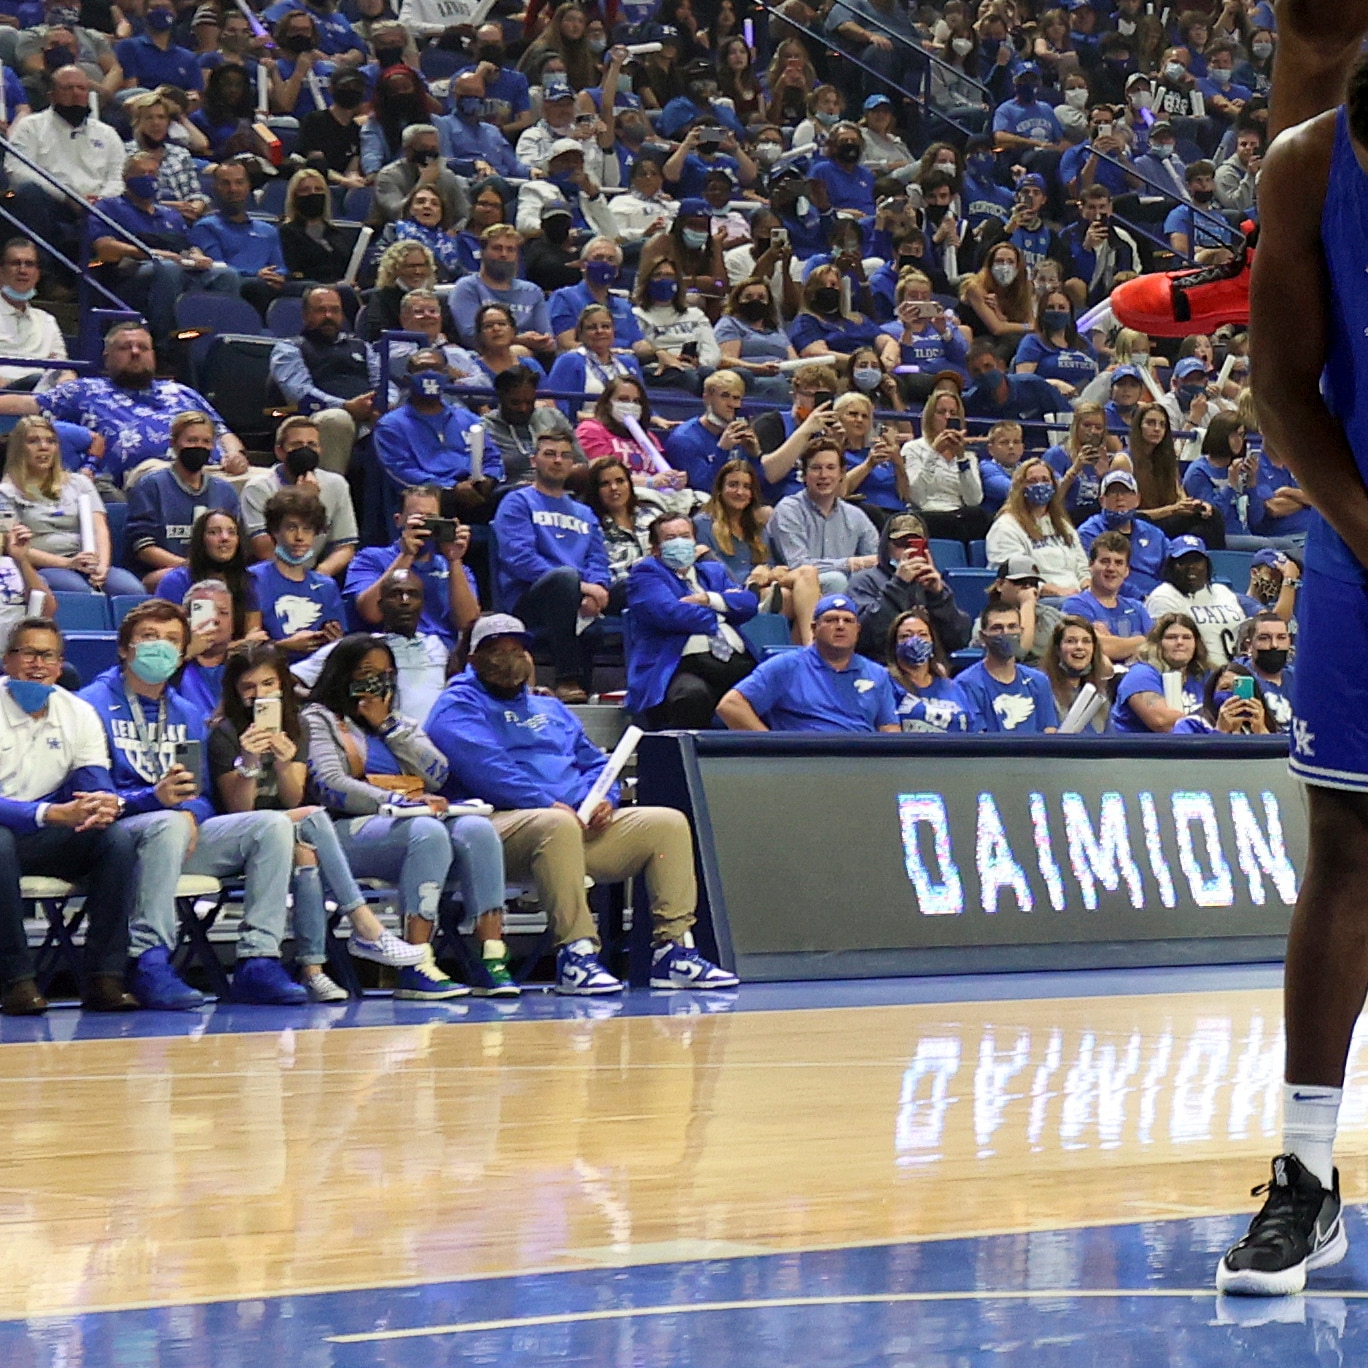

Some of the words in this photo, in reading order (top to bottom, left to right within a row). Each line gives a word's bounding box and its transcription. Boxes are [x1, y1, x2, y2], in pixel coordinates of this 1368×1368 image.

[532, 510, 590, 536] KENTUCKY
[1190, 605, 1242, 625] CATS
[897, 789, 1298, 915] DAIMION
